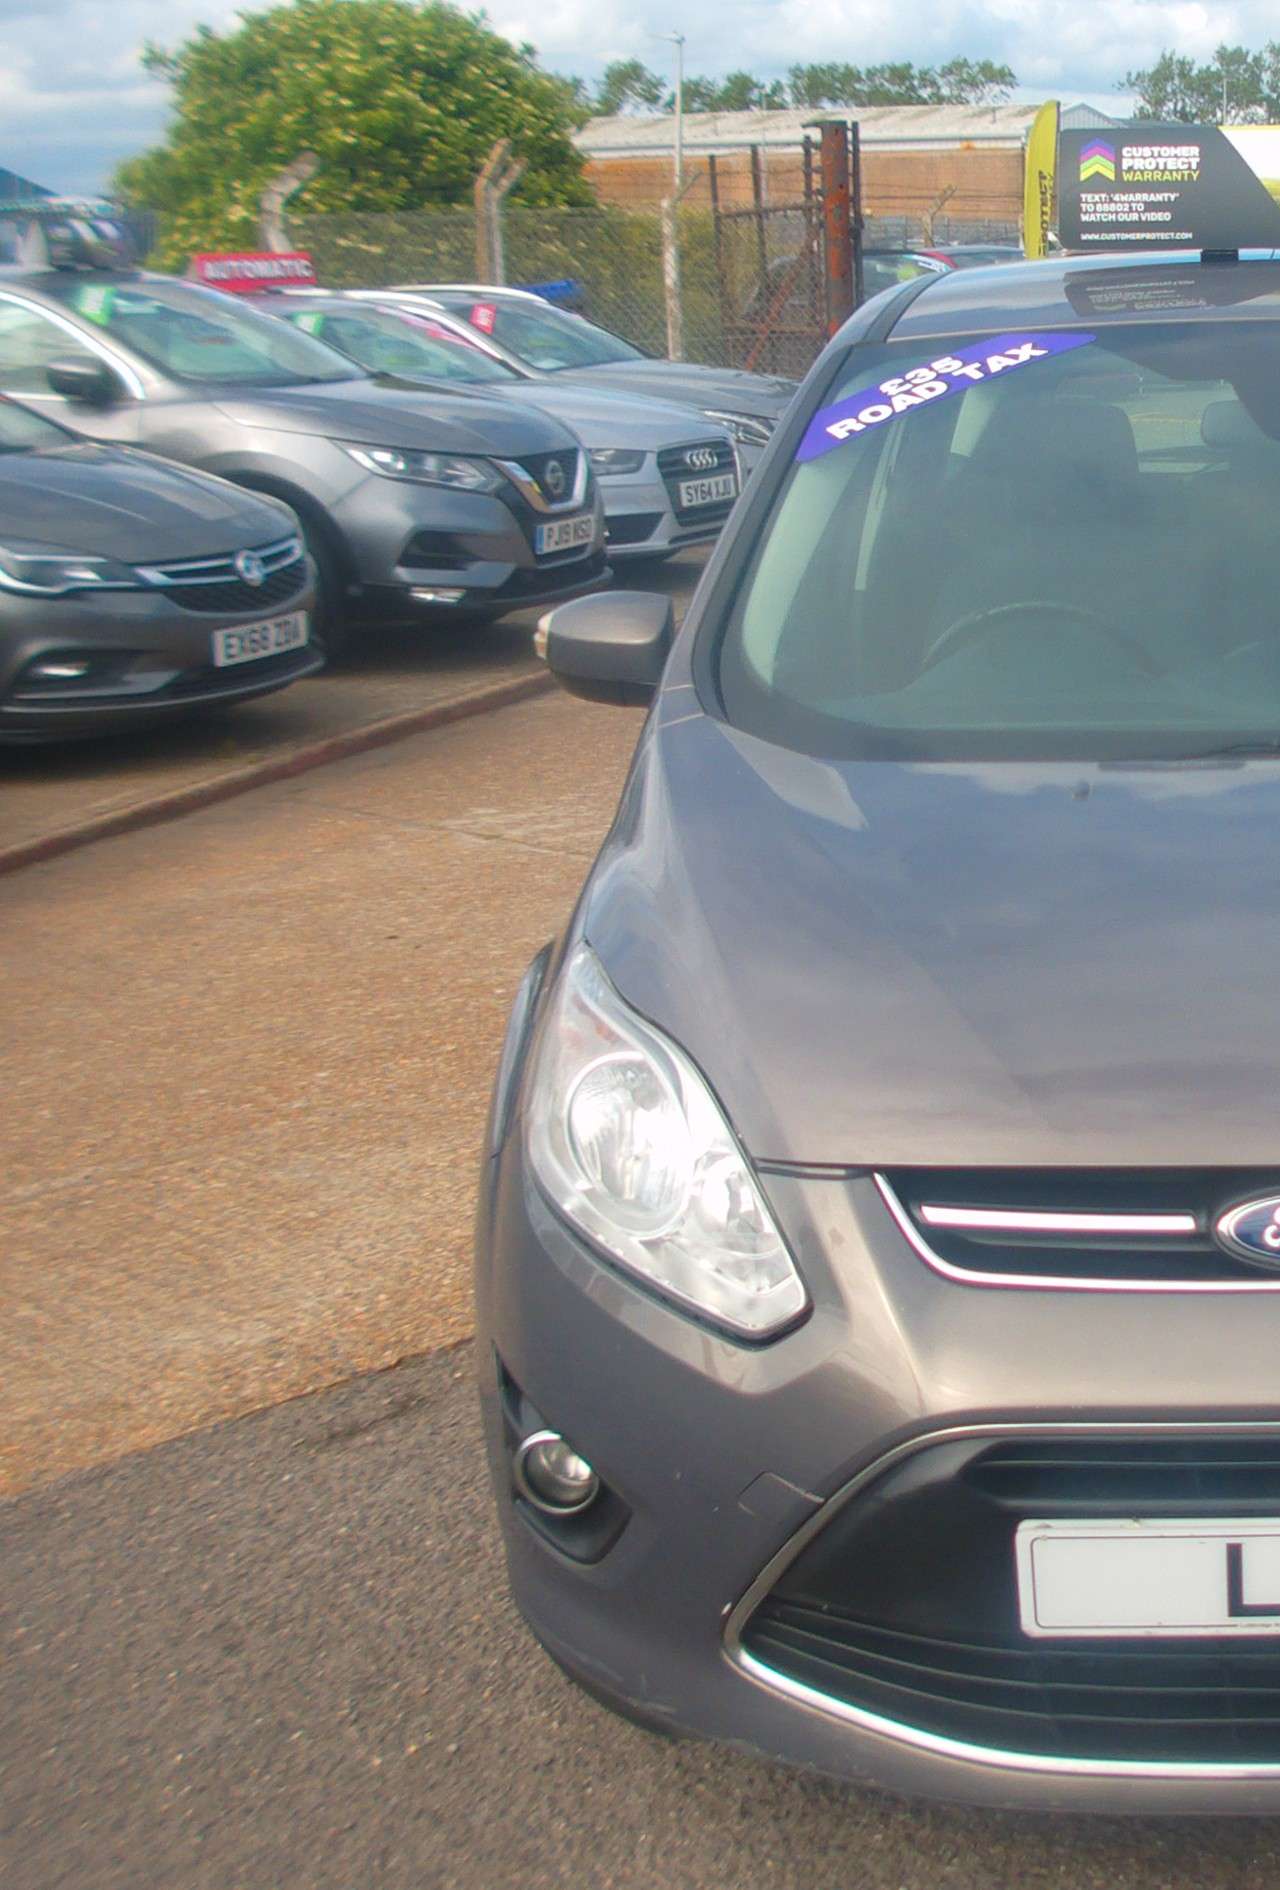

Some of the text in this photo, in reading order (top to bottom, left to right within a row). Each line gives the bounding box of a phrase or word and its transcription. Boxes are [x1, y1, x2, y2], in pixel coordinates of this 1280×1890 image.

[1121, 146, 1200, 158] CUSTOMER
[1121, 157, 1200, 170] PROTECT
[1121, 170, 1200, 182] WARRANTY
[1080, 203, 1095, 212] TO
[1131, 202, 1145, 212] TO
[1080, 211, 1172, 222] WATCH OUR VIDEO
[879, 356, 965, 397] £35
[825, 341, 1049, 440] ROAD TAX
